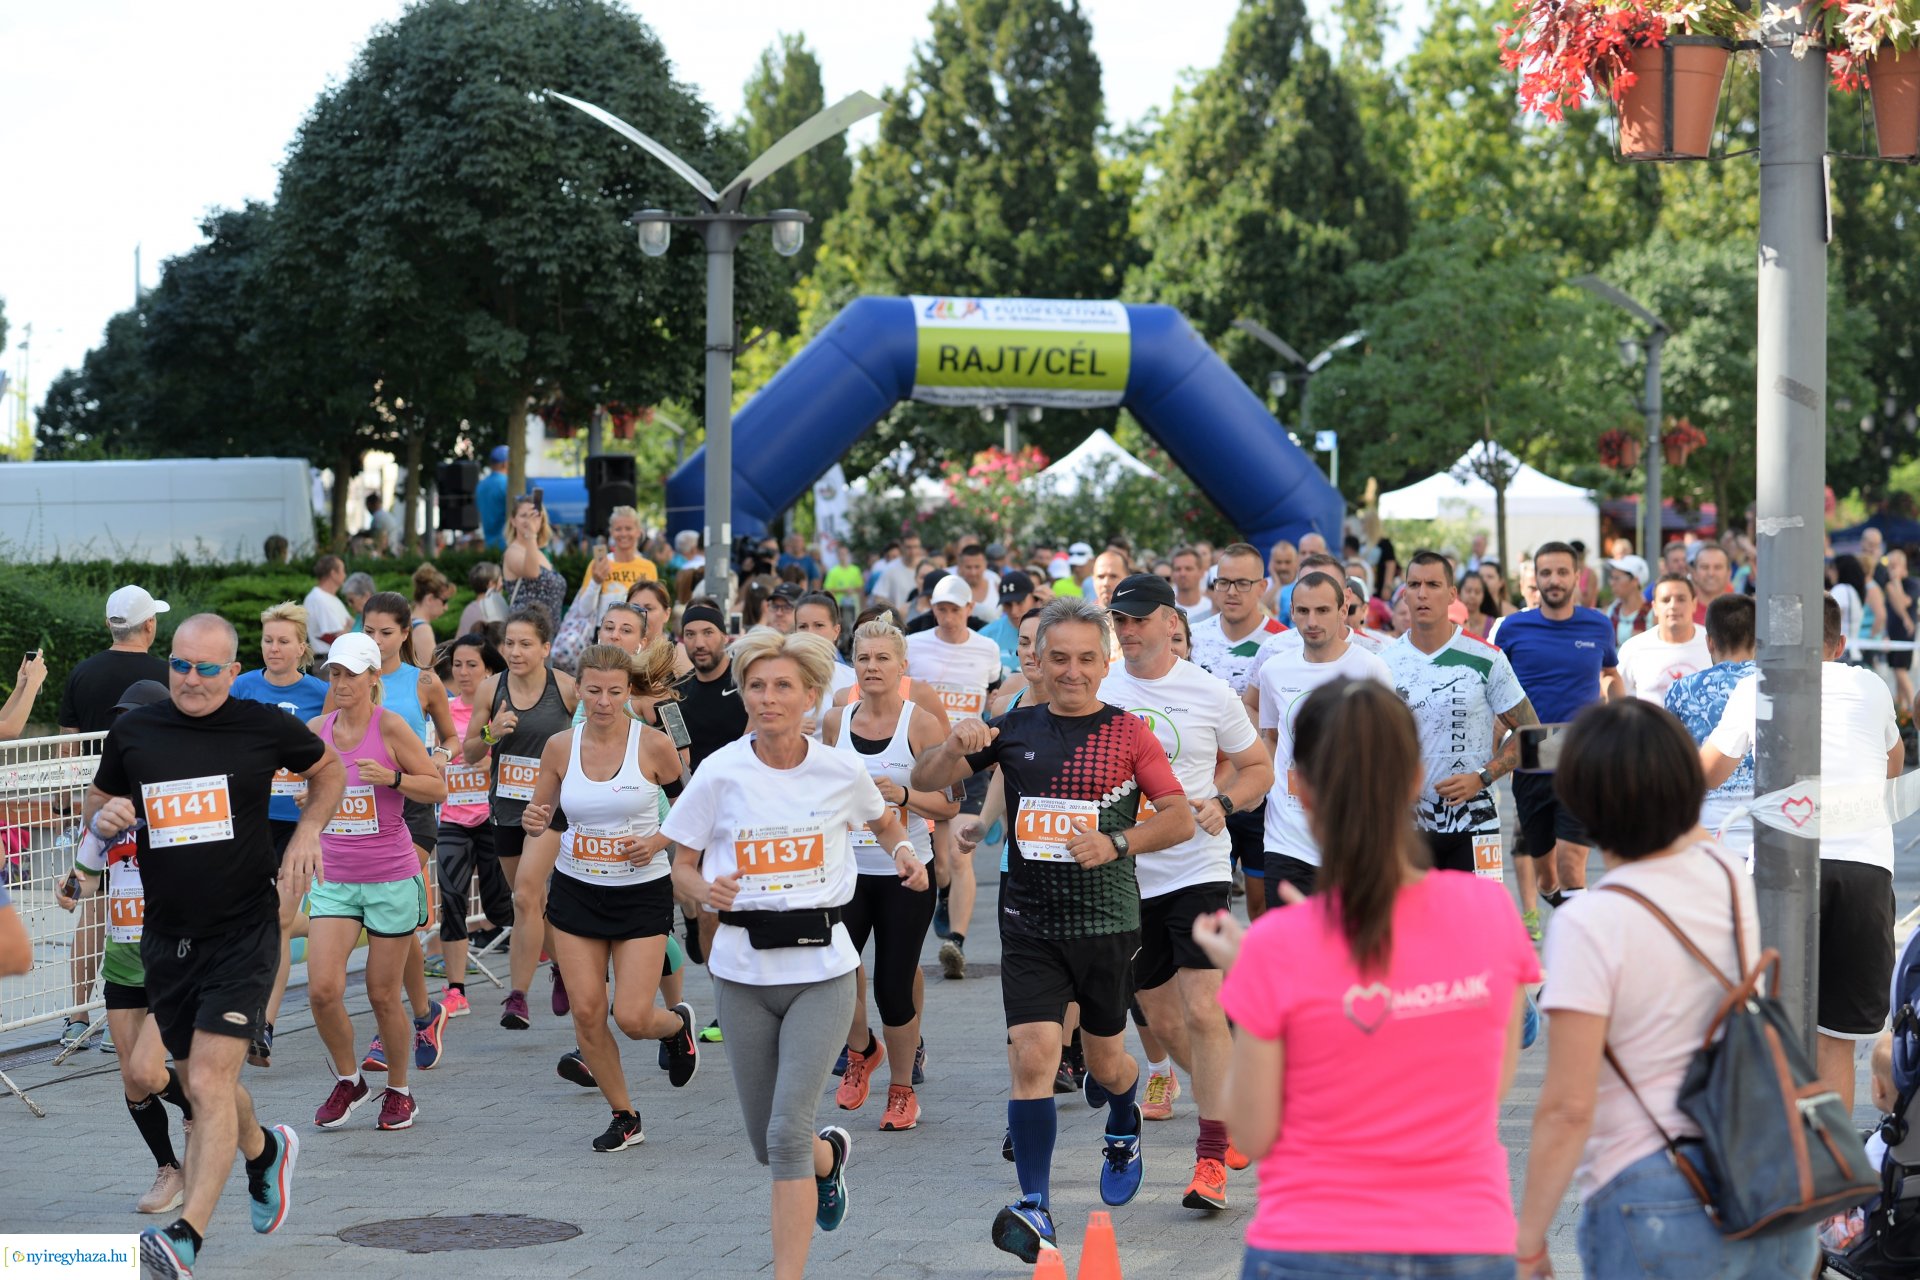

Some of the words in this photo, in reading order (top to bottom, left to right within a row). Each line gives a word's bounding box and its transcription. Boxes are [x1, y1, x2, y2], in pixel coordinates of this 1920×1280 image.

[938, 340, 1107, 376] RAJT/CÉL
[939, 692, 977, 708] 1024
[450, 772, 486, 788] 1115
[503, 765, 540, 783] 109
[152, 791, 217, 820] 1141
[742, 837, 816, 866] 1137
